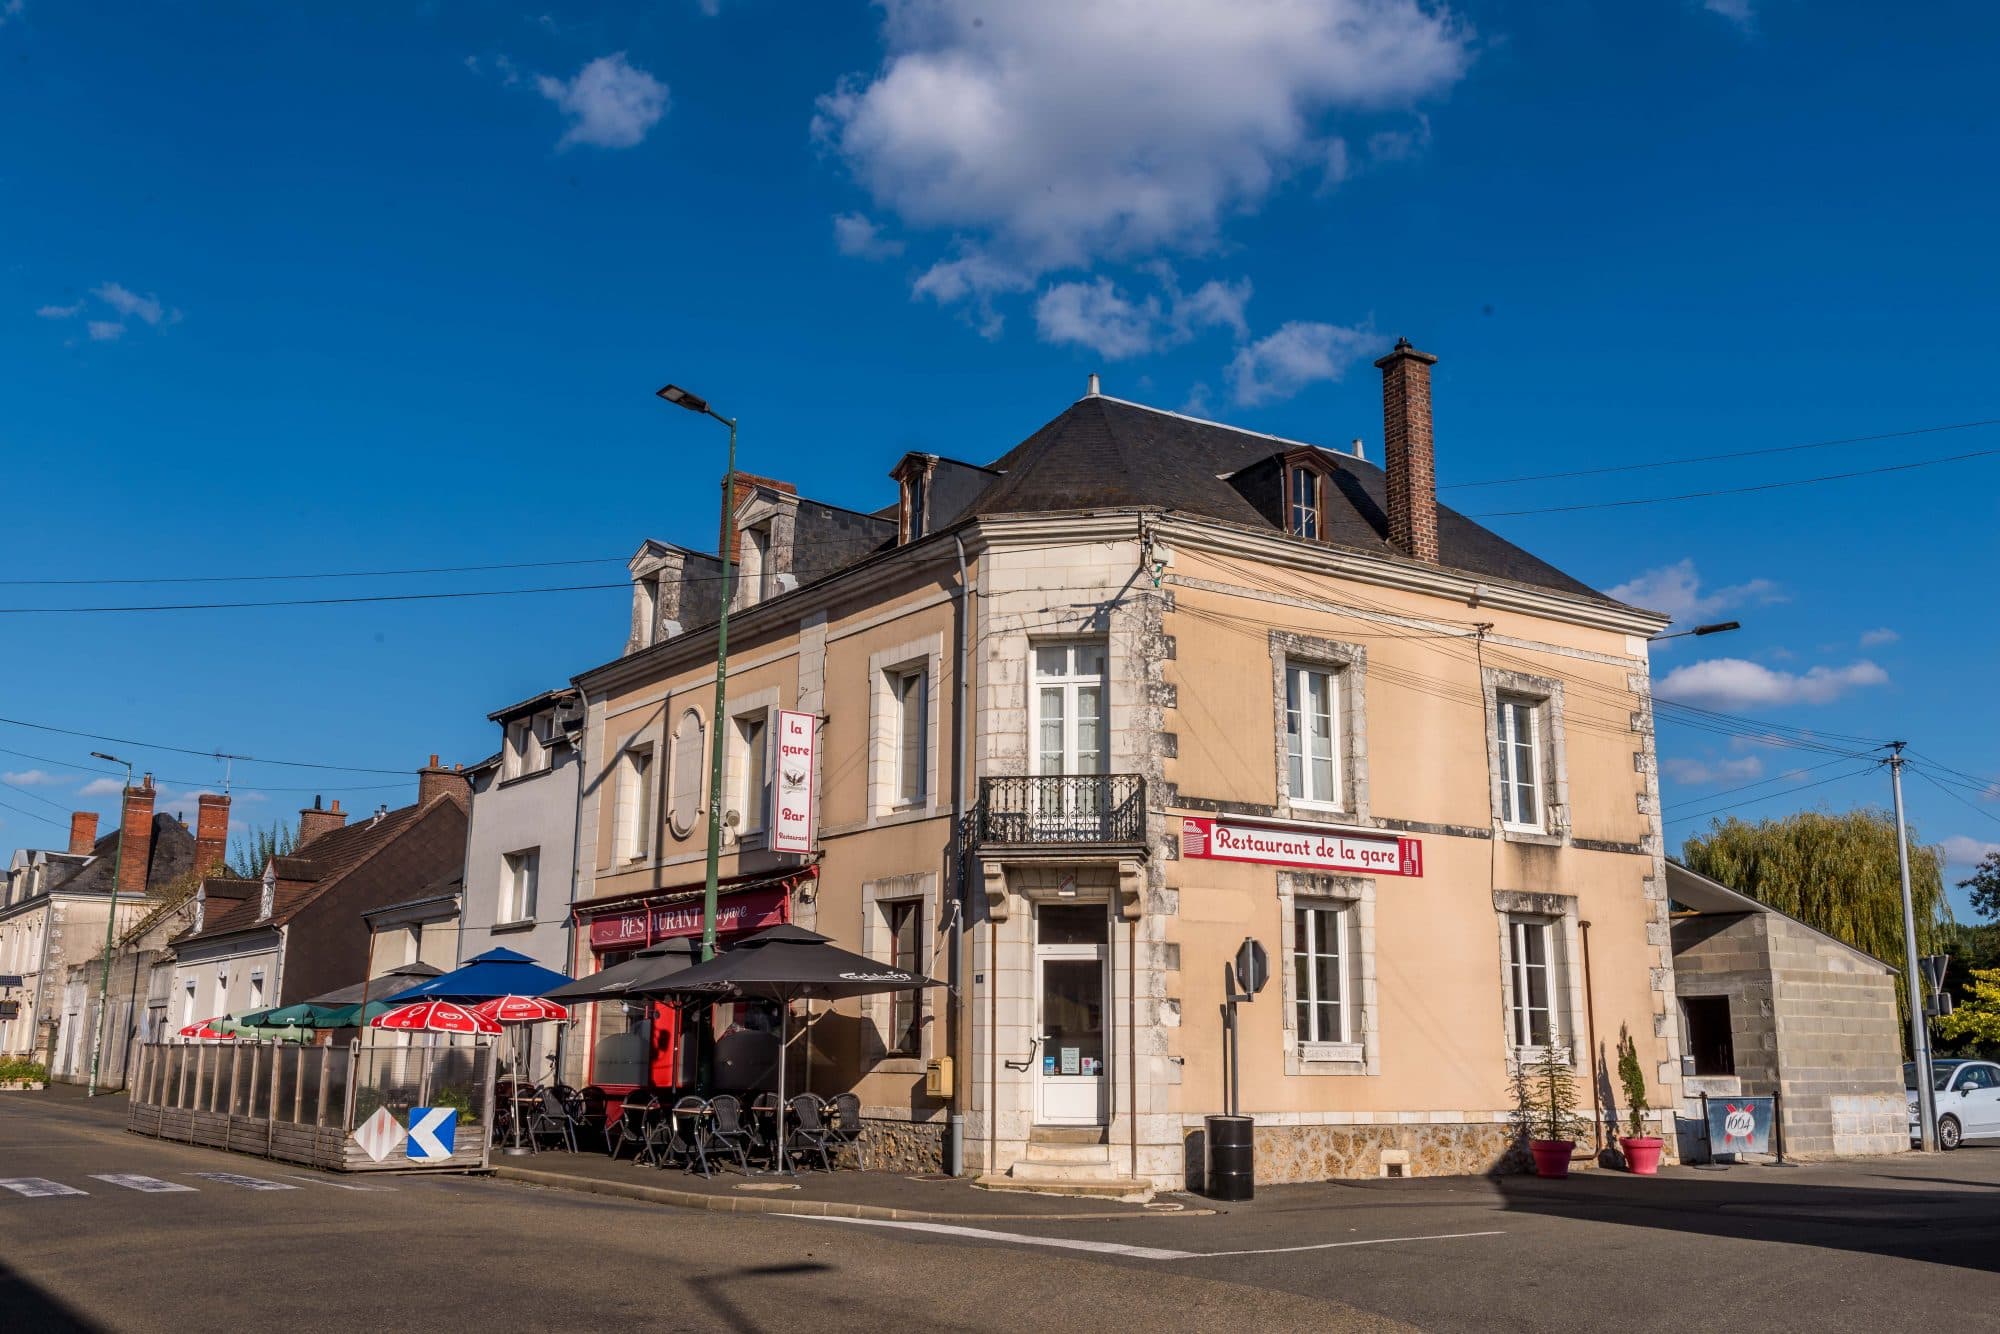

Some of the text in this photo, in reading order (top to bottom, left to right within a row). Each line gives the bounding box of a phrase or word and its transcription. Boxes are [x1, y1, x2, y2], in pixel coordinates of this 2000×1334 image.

[790, 721, 802, 735] la
[782, 745, 809, 757] gare
[782, 808, 805, 821] Bar
[778, 831, 808, 841] Restaurant
[1216, 828, 1395, 866] Restaurant de la gare
[619, 907, 700, 938] RESAURANT
[839, 970, 912, 981] Carlsberg
[1727, 1115, 1753, 1130] 1664
